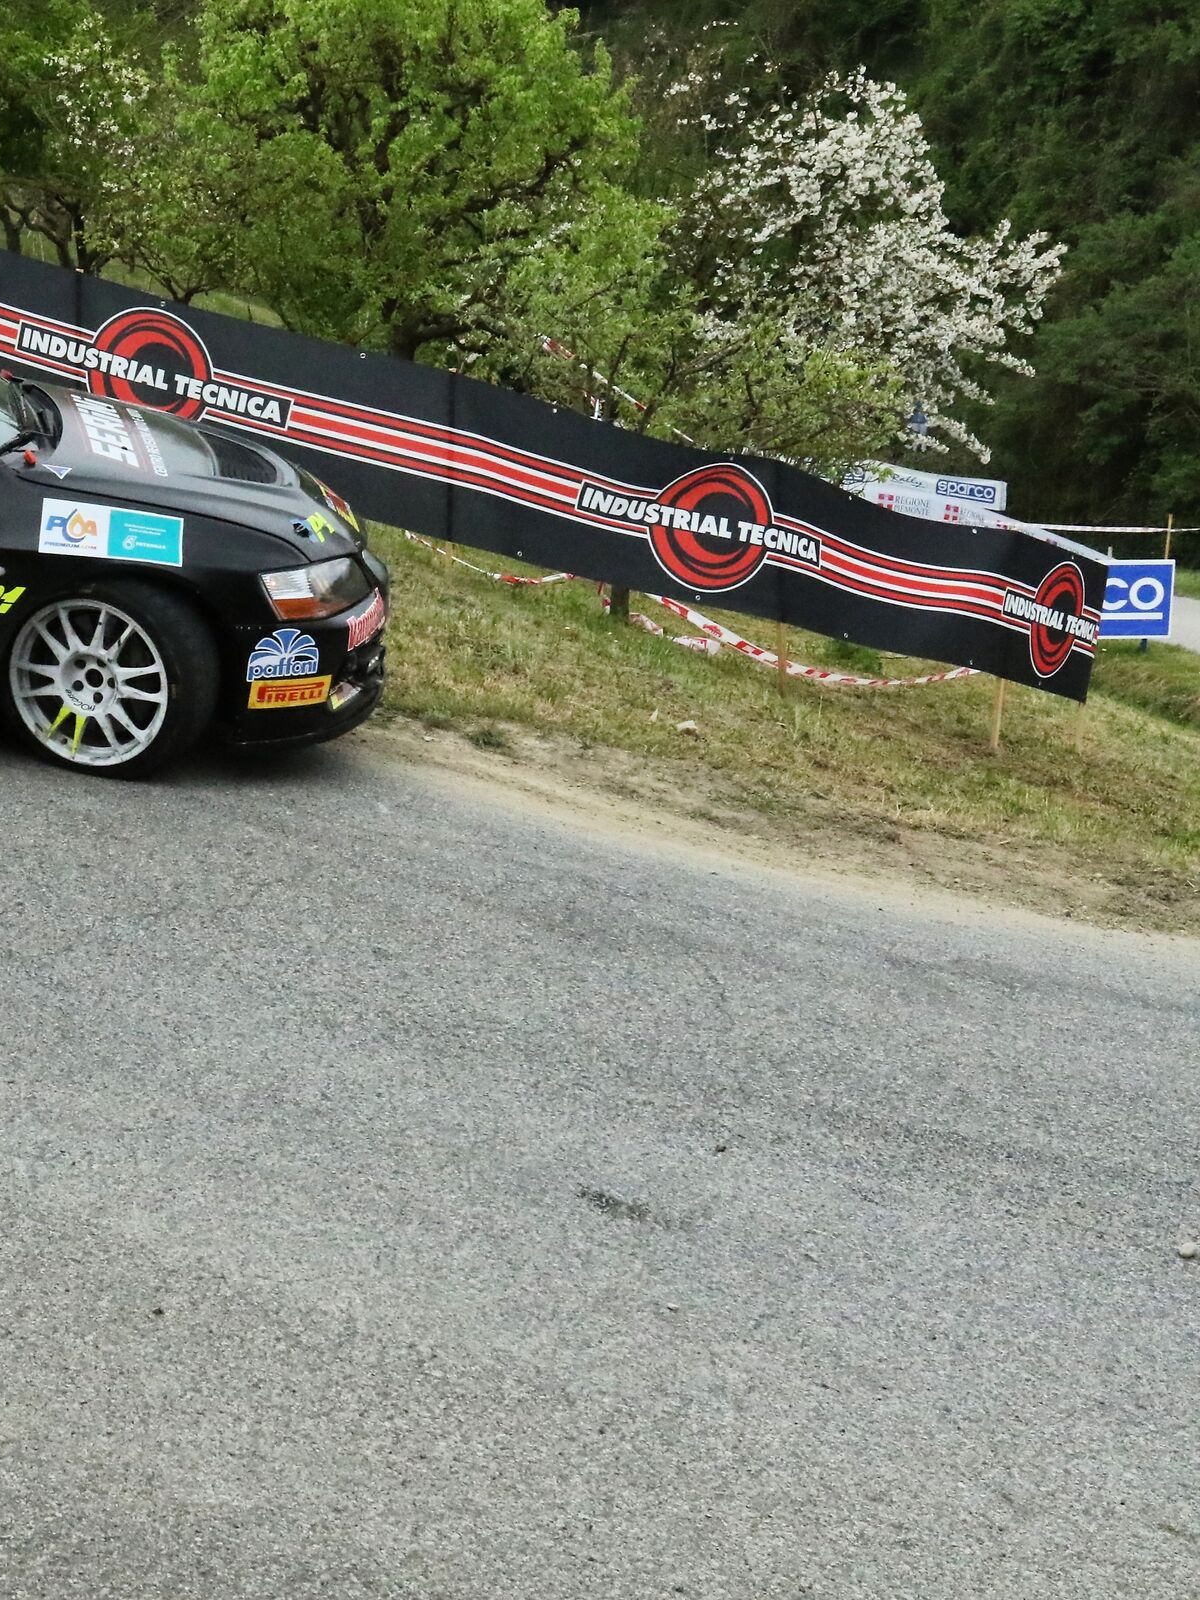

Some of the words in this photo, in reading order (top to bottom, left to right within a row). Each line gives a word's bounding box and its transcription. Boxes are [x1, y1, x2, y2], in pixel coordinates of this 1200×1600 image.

[21, 328, 169, 391] INDUSTRIAL
[174, 374, 281, 424] TECNICA
[937, 481, 995, 500] sparco
[581, 487, 732, 539] INDUSTRIAL
[738, 521, 818, 562] TECNICA
[1004, 593, 1065, 631] INDUSTRIAL
[248, 656, 318, 681] paffoni
[256, 681, 325, 703] PIRELLI
